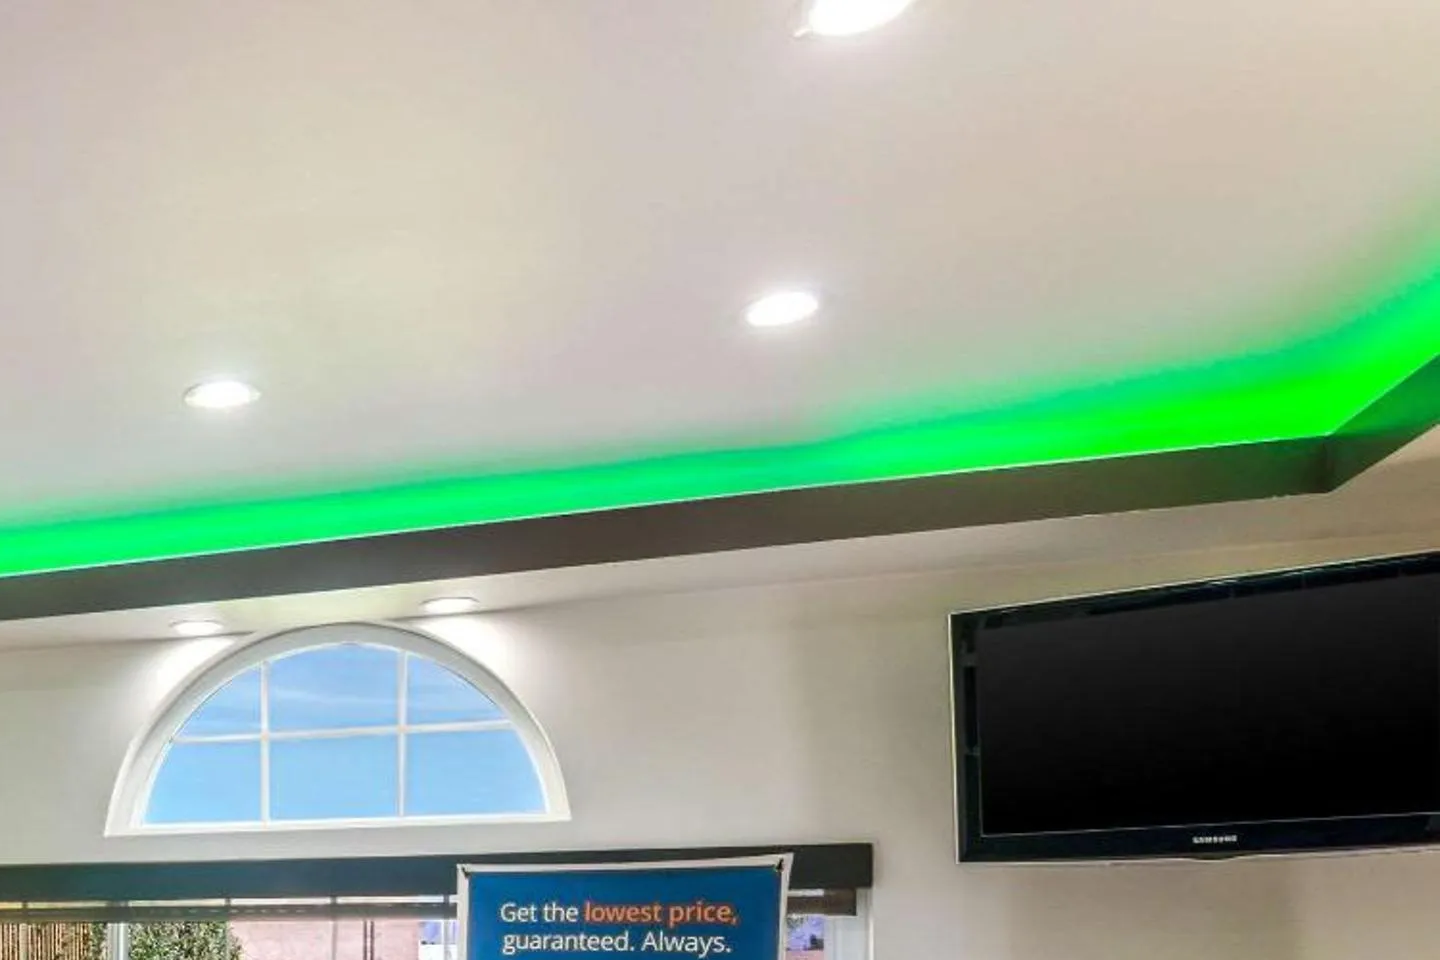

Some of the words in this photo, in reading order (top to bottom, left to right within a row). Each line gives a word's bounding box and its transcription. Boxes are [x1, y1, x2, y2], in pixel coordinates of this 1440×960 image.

[500, 903, 537, 922] Get
[543, 902, 578, 922] the
[584, 901, 662, 923] lowest
[668, 900, 738, 928] price,
[502, 931, 635, 955] guaranteed.
[641, 931, 732, 957] Always.
